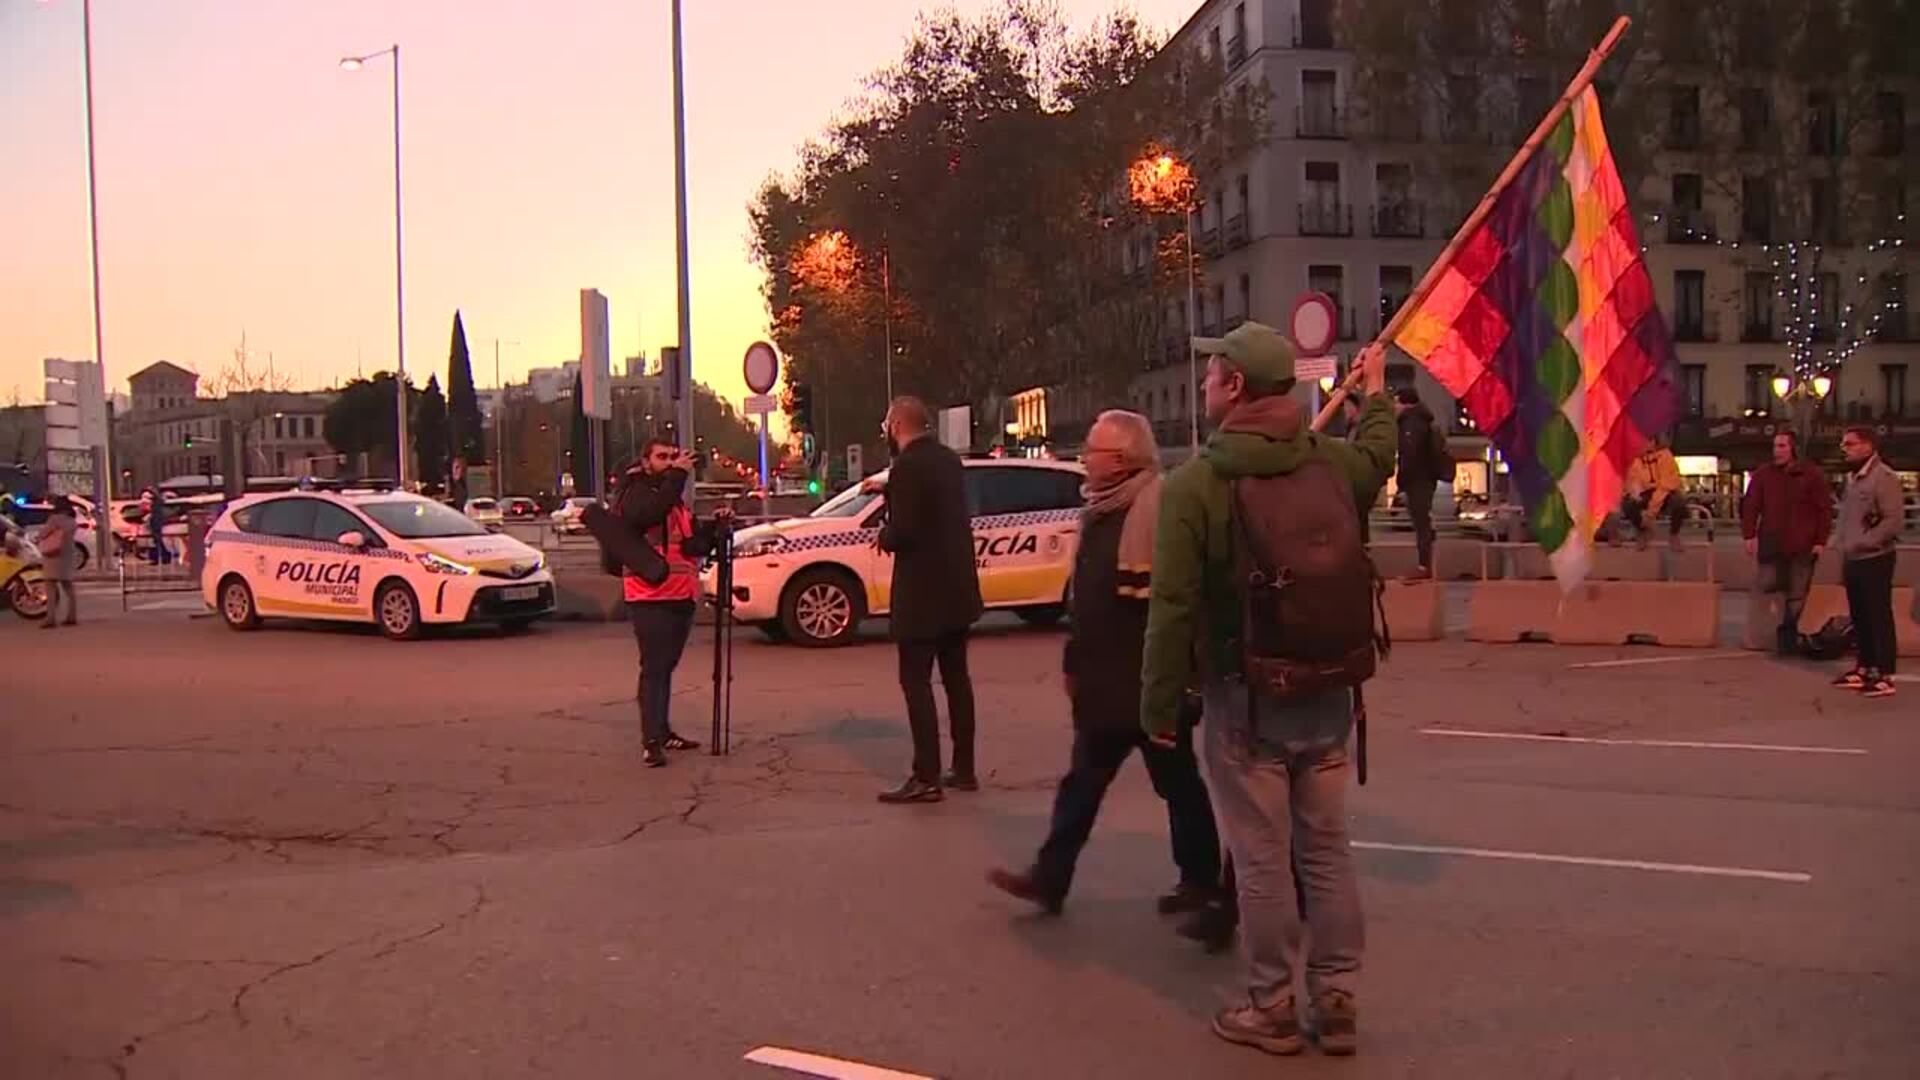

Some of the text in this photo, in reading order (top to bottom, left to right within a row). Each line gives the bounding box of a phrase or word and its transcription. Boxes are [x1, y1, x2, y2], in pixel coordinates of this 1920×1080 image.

[974, 531, 1038, 556] ICÍA
[276, 560, 361, 584] POLICÍA
[305, 584, 360, 596] MUNICIPAL
